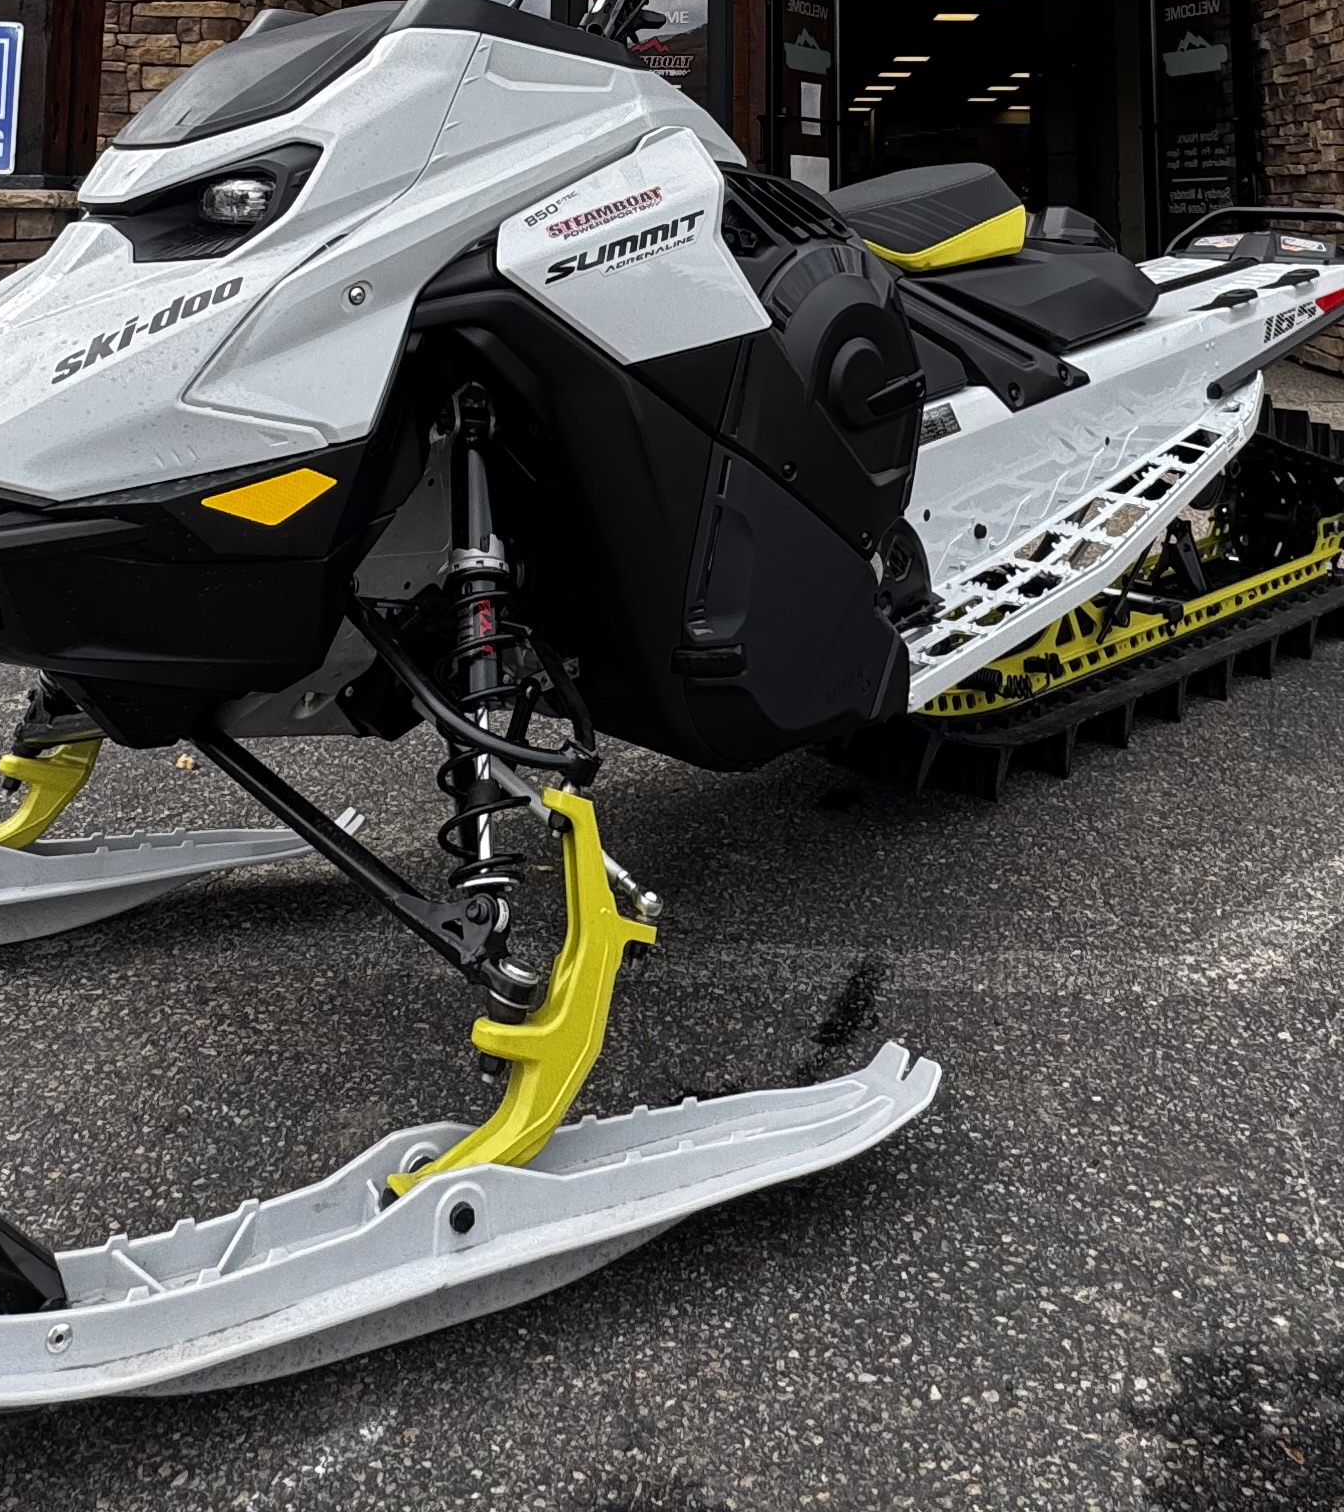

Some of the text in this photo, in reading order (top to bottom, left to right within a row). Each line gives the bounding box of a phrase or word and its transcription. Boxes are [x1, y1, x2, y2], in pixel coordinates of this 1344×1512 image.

[524, 203, 559, 227] 850
[547, 186, 662, 237] STEAMBOAT
[605, 234, 695, 273] ADRENALINE
